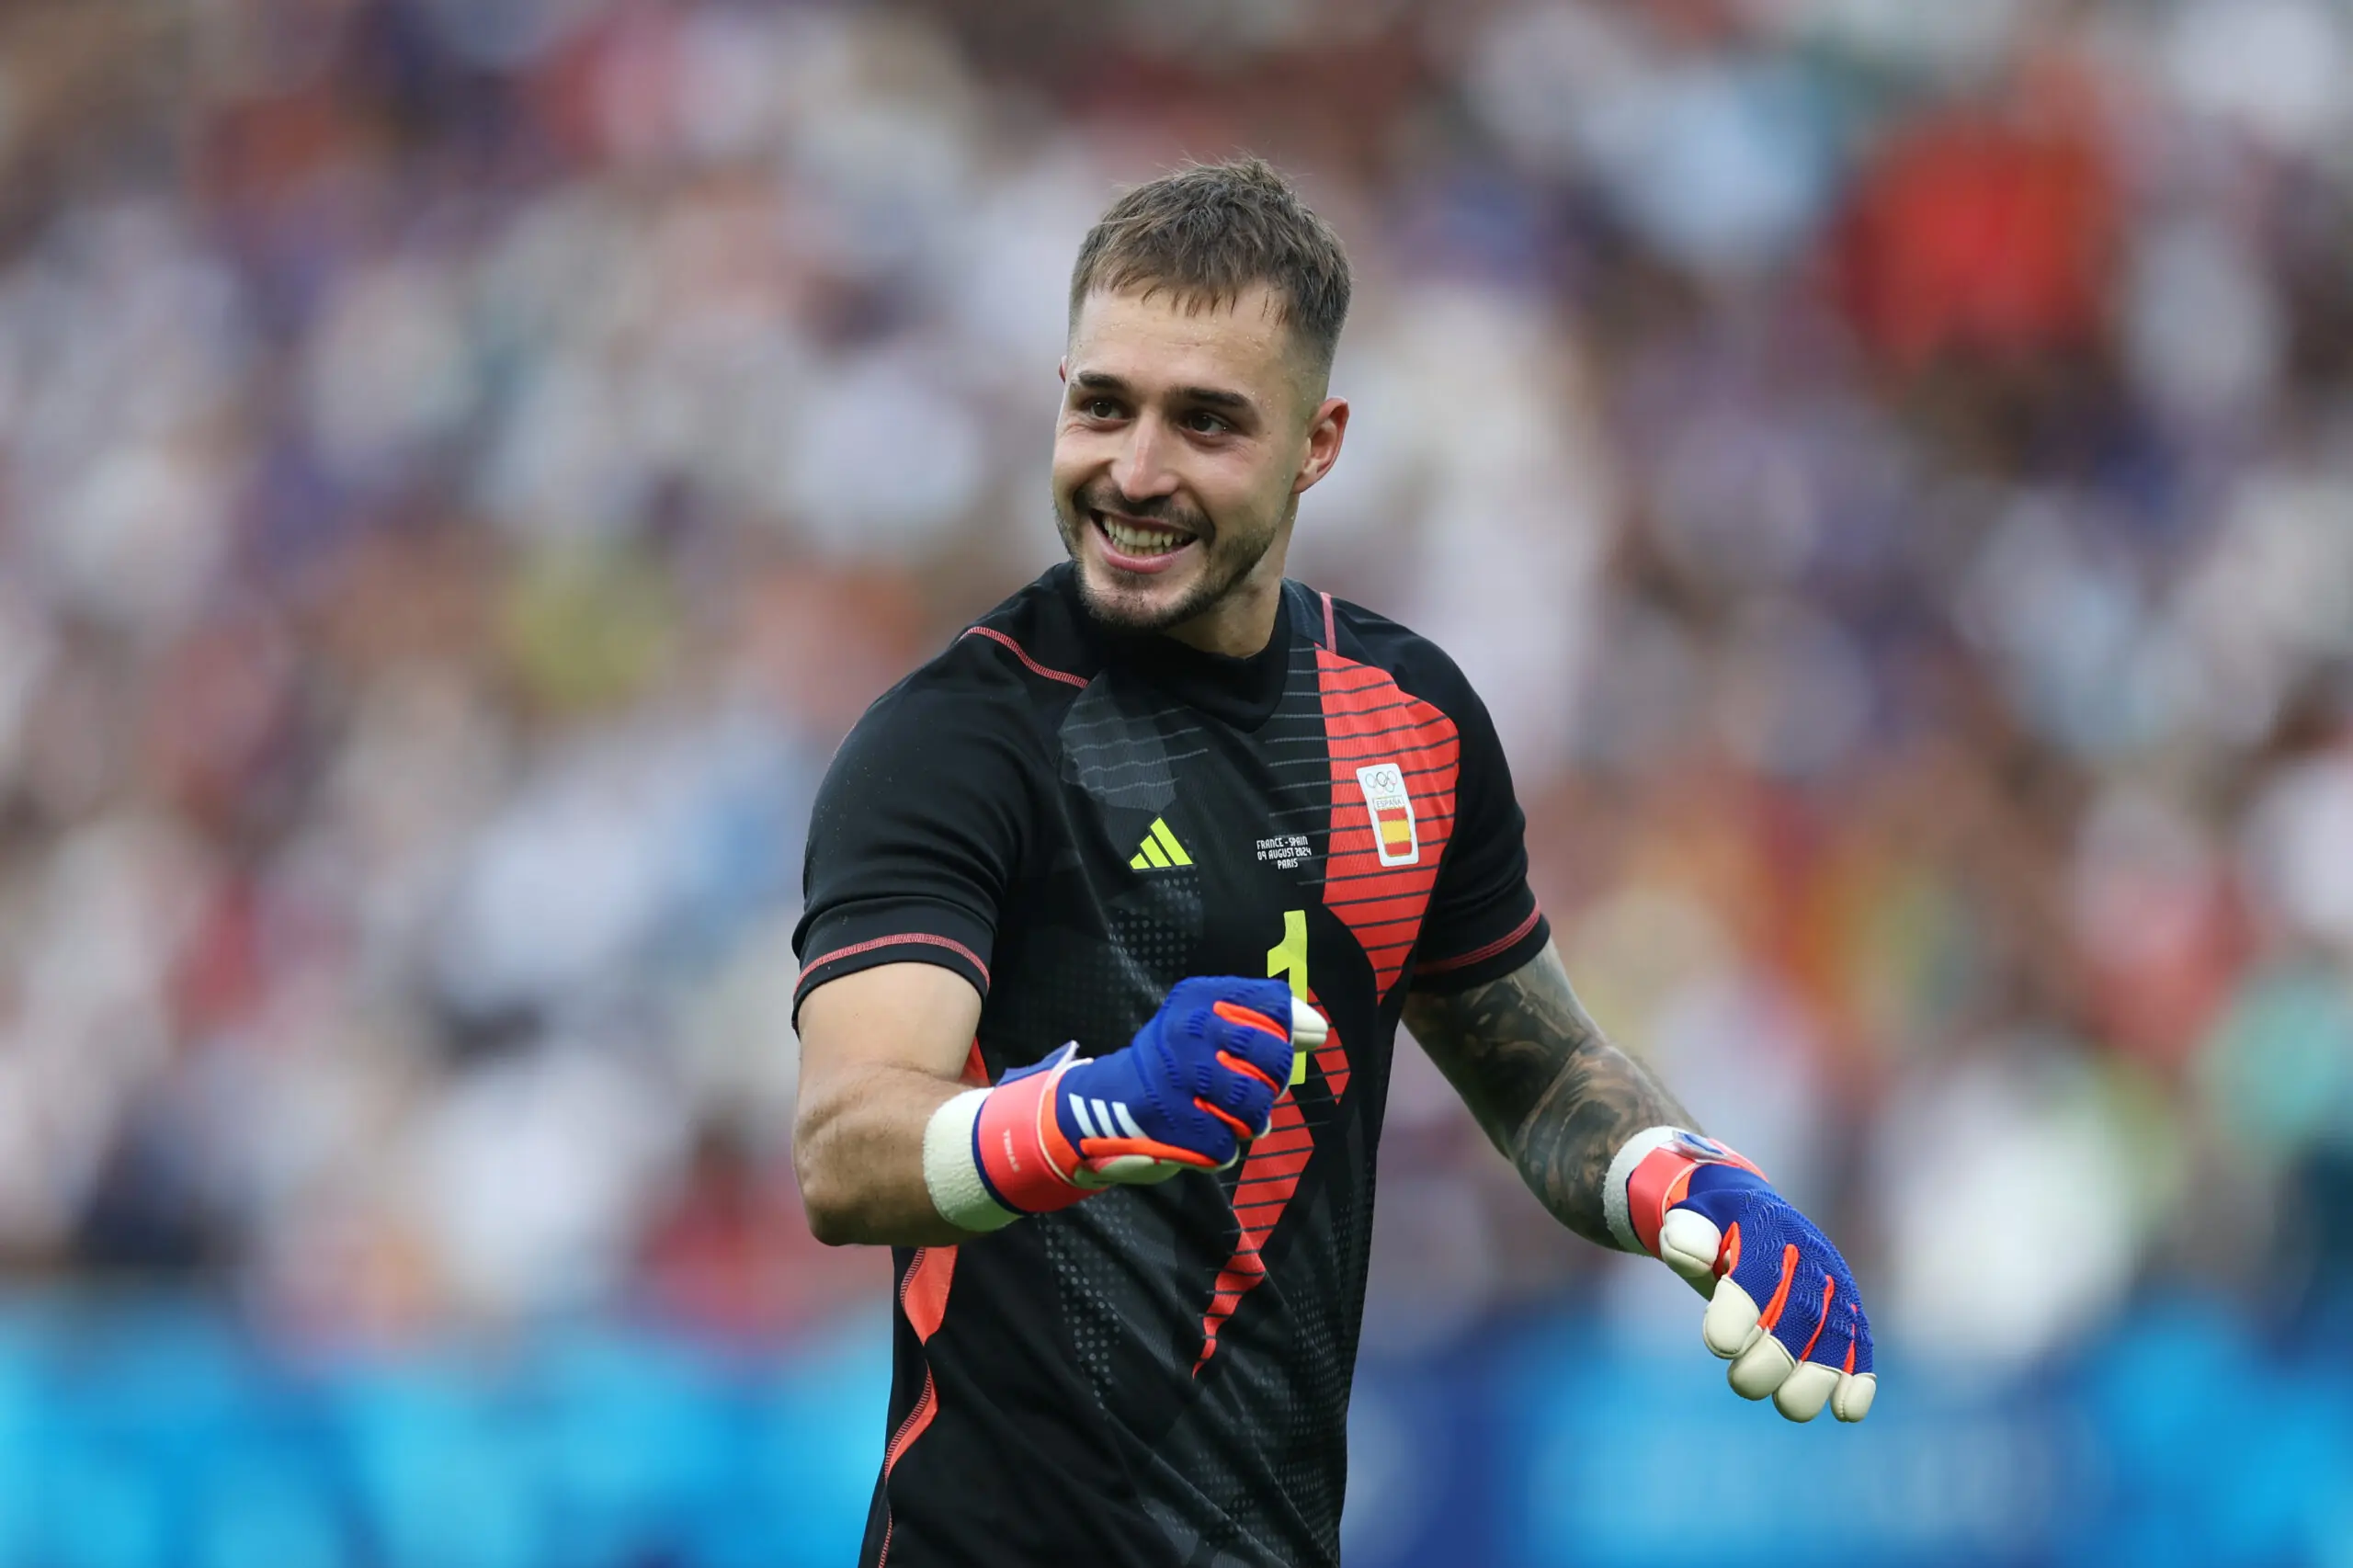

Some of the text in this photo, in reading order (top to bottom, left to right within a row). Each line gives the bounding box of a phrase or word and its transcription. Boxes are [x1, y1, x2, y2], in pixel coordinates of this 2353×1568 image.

[1376, 798, 1402, 809] ESPAÑA
[1256, 837, 1284, 850] FRANCE
[1289, 835, 1309, 846] SPAIN
[1256, 846, 1313, 860] 09 AUGUST 2024
[1277, 858, 1299, 870] PARIS
[1267, 909, 1308, 1085] 1
